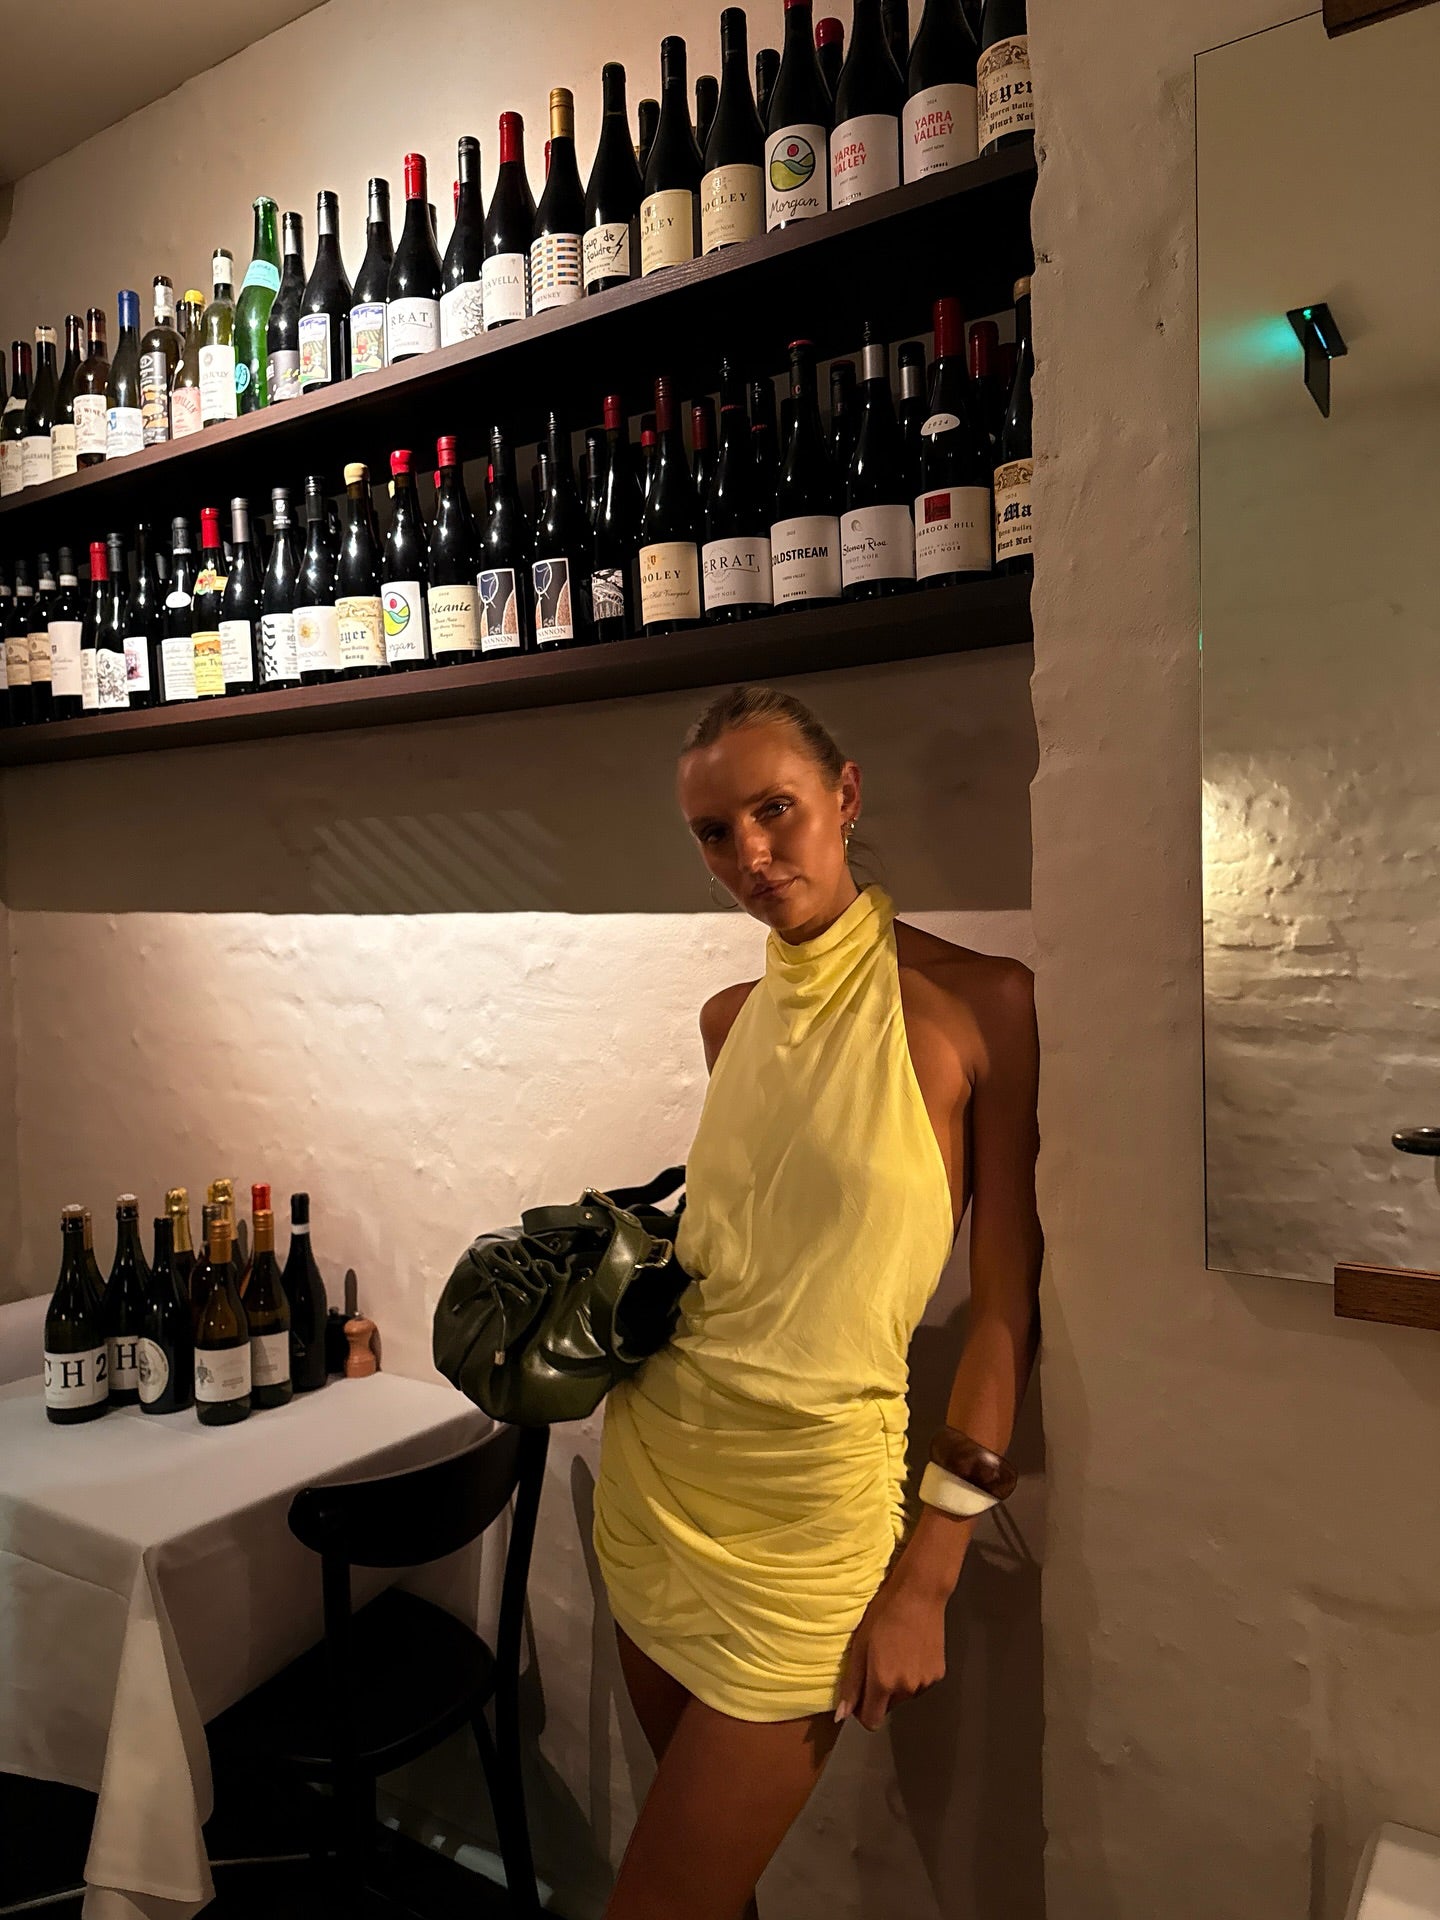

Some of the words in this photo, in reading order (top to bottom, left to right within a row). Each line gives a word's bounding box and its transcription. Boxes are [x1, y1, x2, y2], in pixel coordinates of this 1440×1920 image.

[914, 110, 953, 132] YARRA
[913, 122, 954, 145] VALLEY
[834, 142, 866, 165] YARRA
[833, 153, 868, 177] VALLEY
[769, 198, 820, 219] Morgan
[603, 228, 616, 243] de
[953, 520, 976, 530] HILL
